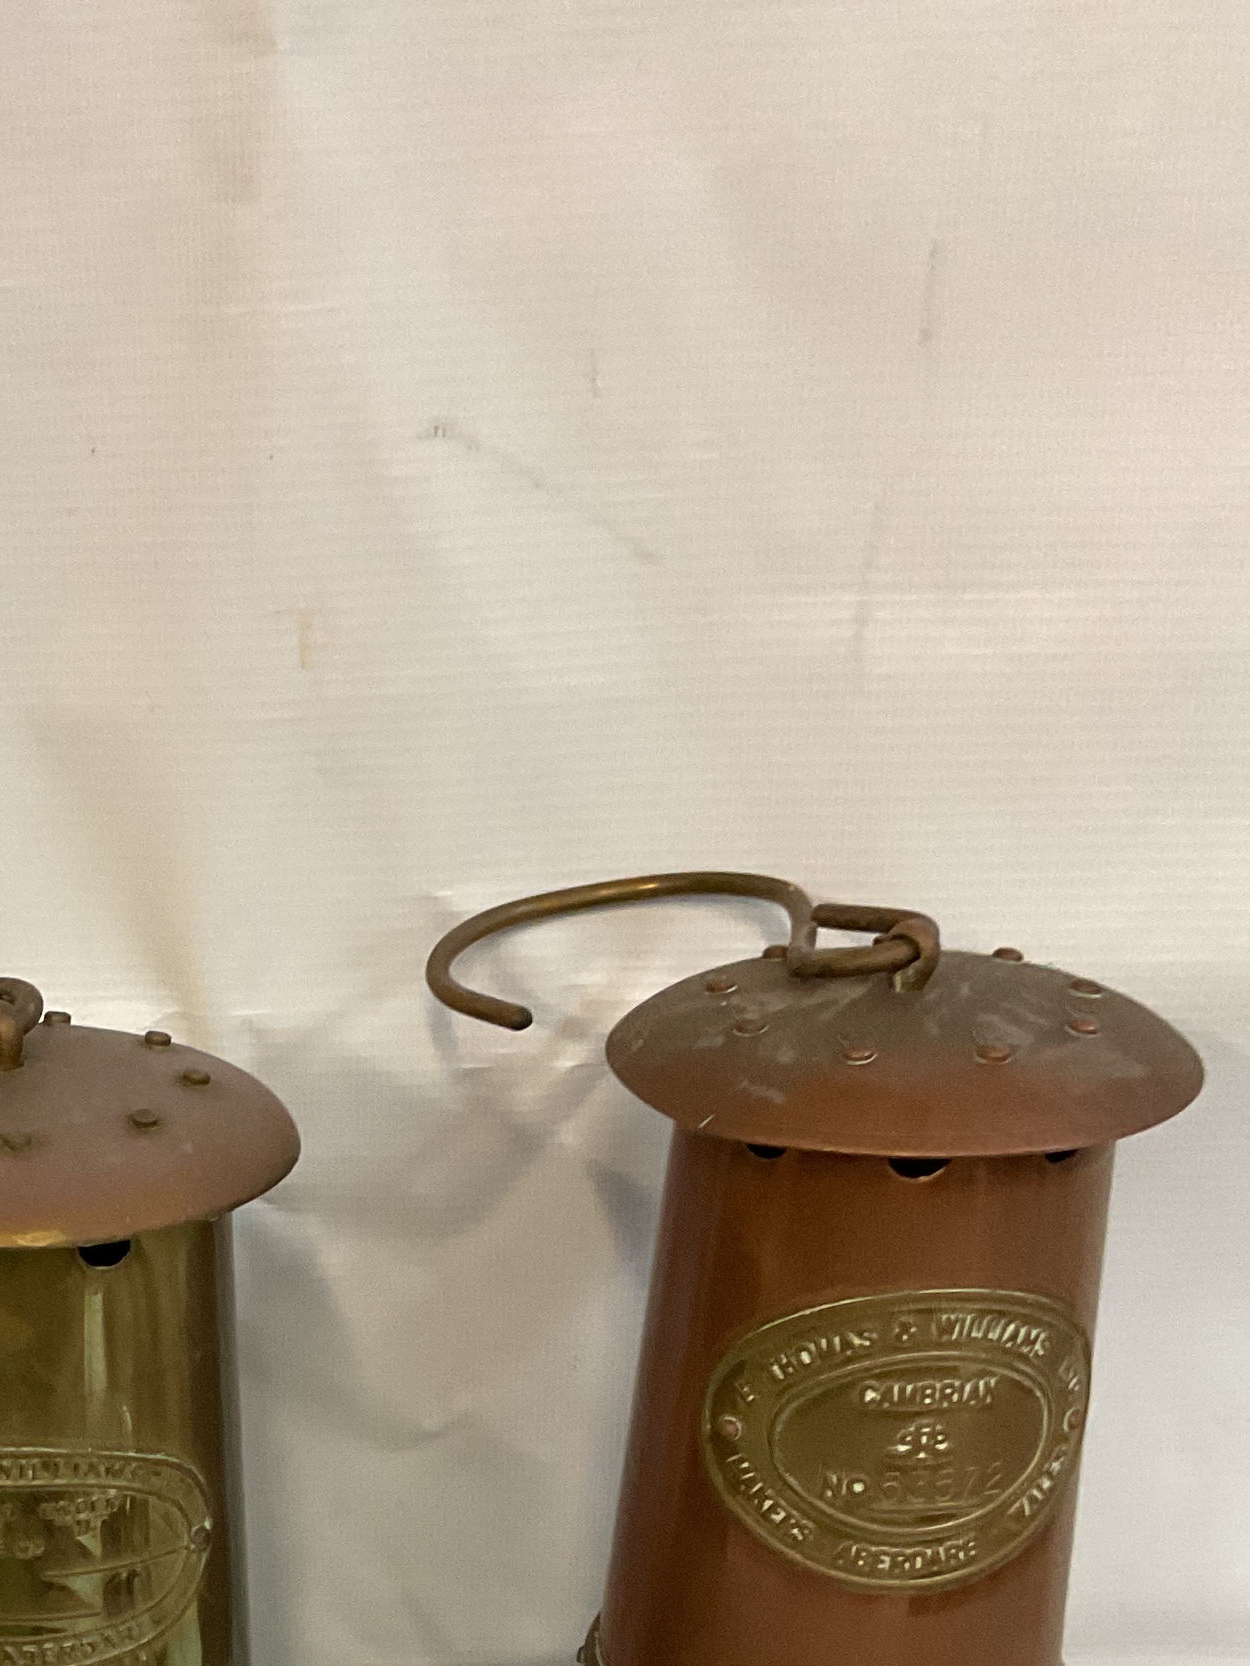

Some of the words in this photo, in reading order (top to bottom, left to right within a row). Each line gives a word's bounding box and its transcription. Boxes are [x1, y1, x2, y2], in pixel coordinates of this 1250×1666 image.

[930, 1311, 1052, 1358] WILLIAMS
[858, 1375, 1000, 1410] CAMBRIAN
[832, 1532, 979, 1573] ABERDARE
